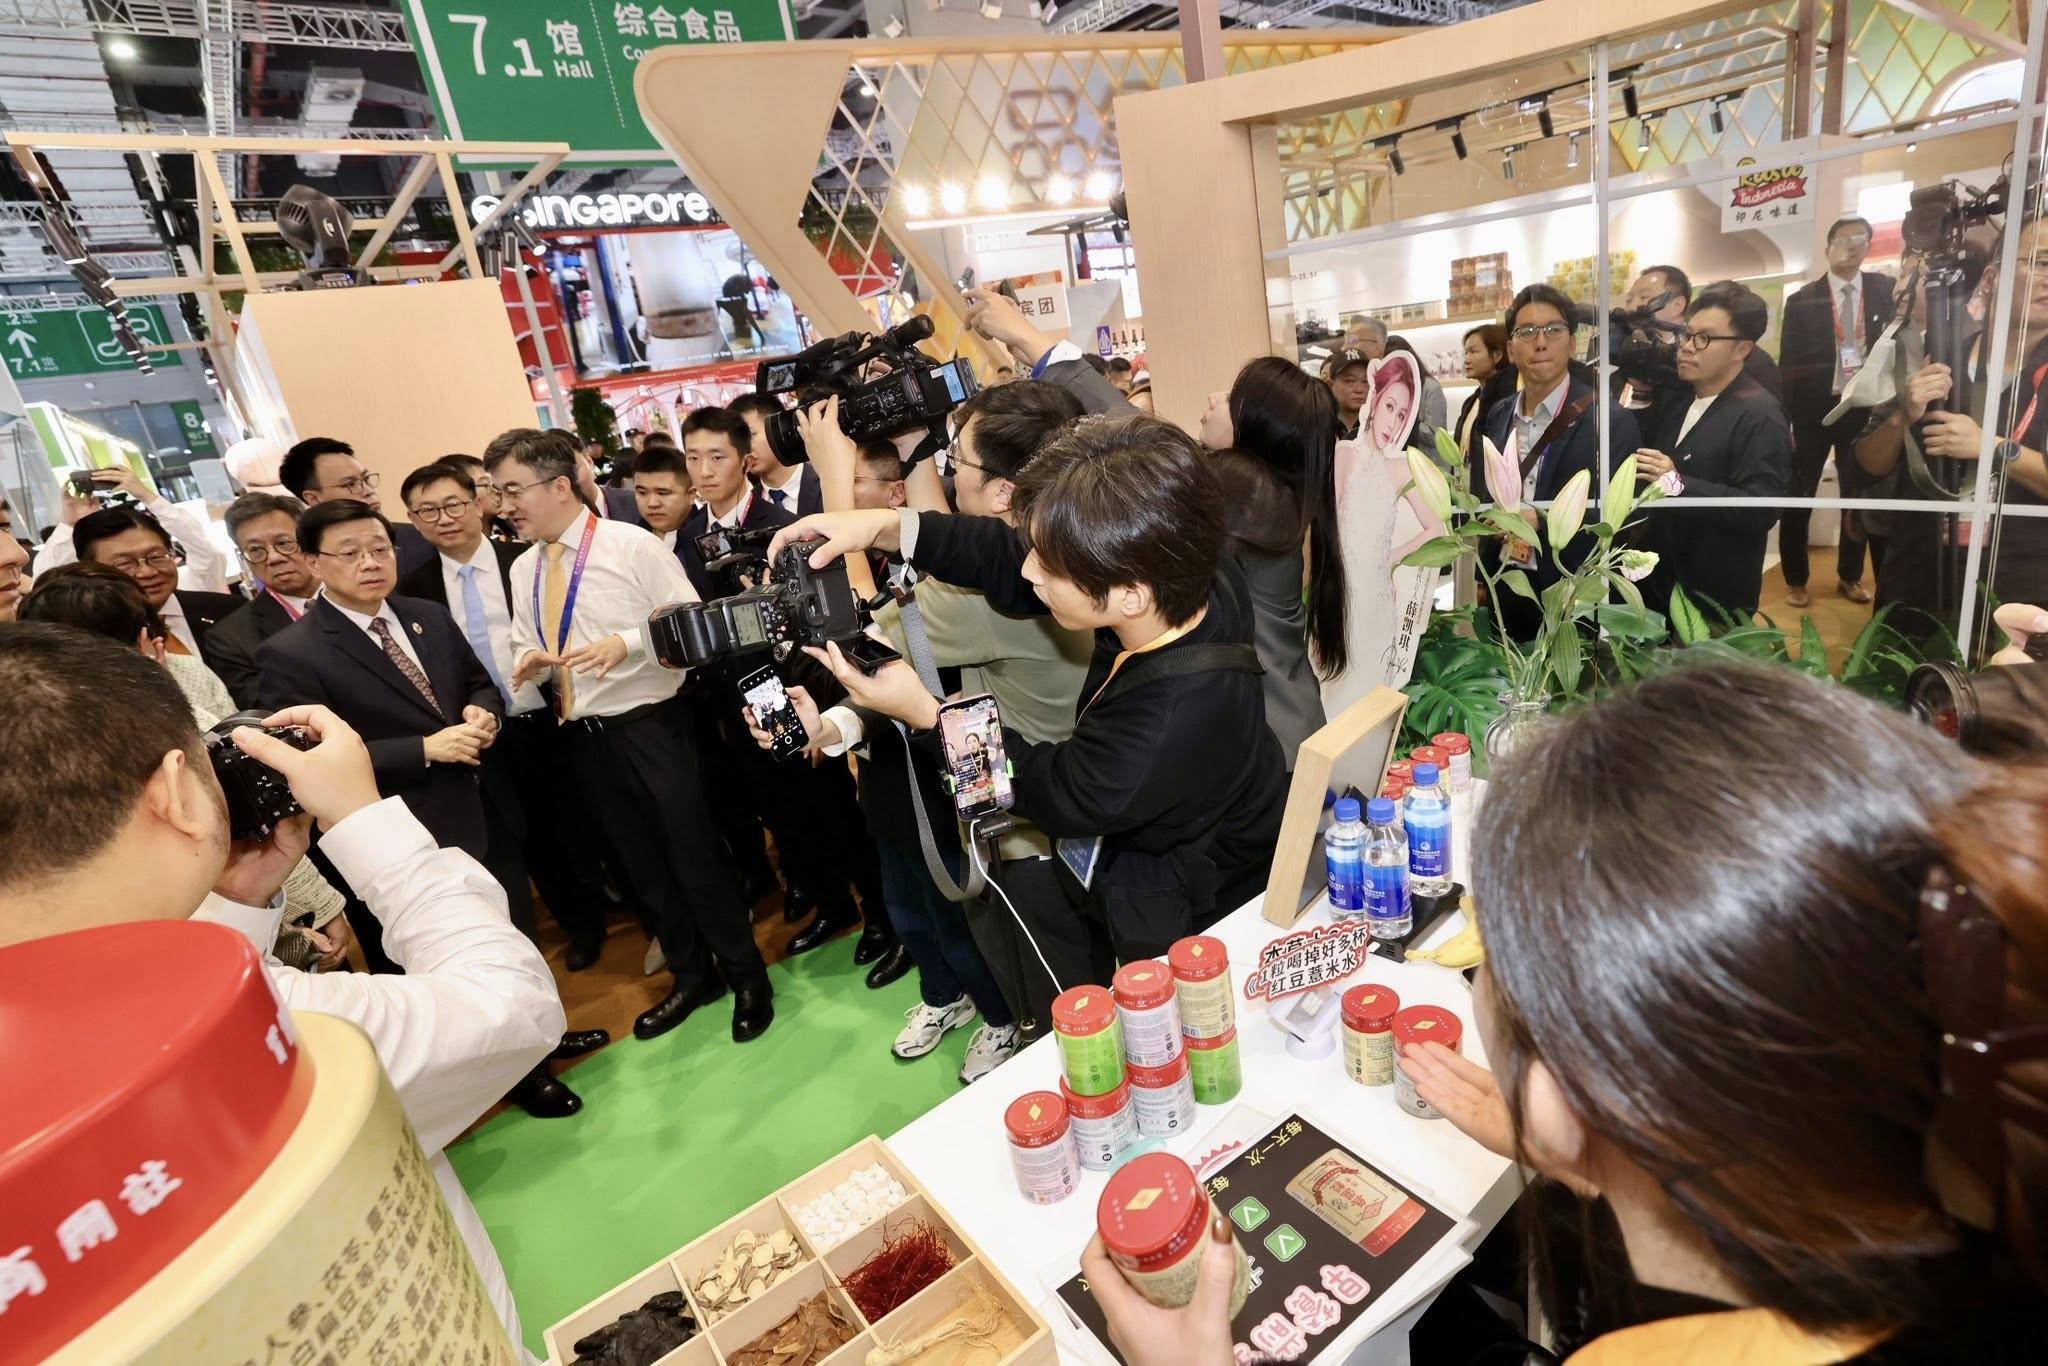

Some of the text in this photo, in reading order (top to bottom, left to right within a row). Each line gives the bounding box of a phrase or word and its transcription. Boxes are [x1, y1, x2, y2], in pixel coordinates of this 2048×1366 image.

[546, 20, 584, 57] 馆
[613, 3, 741, 42] 综合食品
[553, 60, 594, 79] Hall
[1741, 181, 1797, 204] Indonesia
[9, 357, 41, 373] 7.1
[1261, 927, 1367, 983] 1粒喝掉好多杯
[1245, 1120, 1303, 1167] 每天一次
